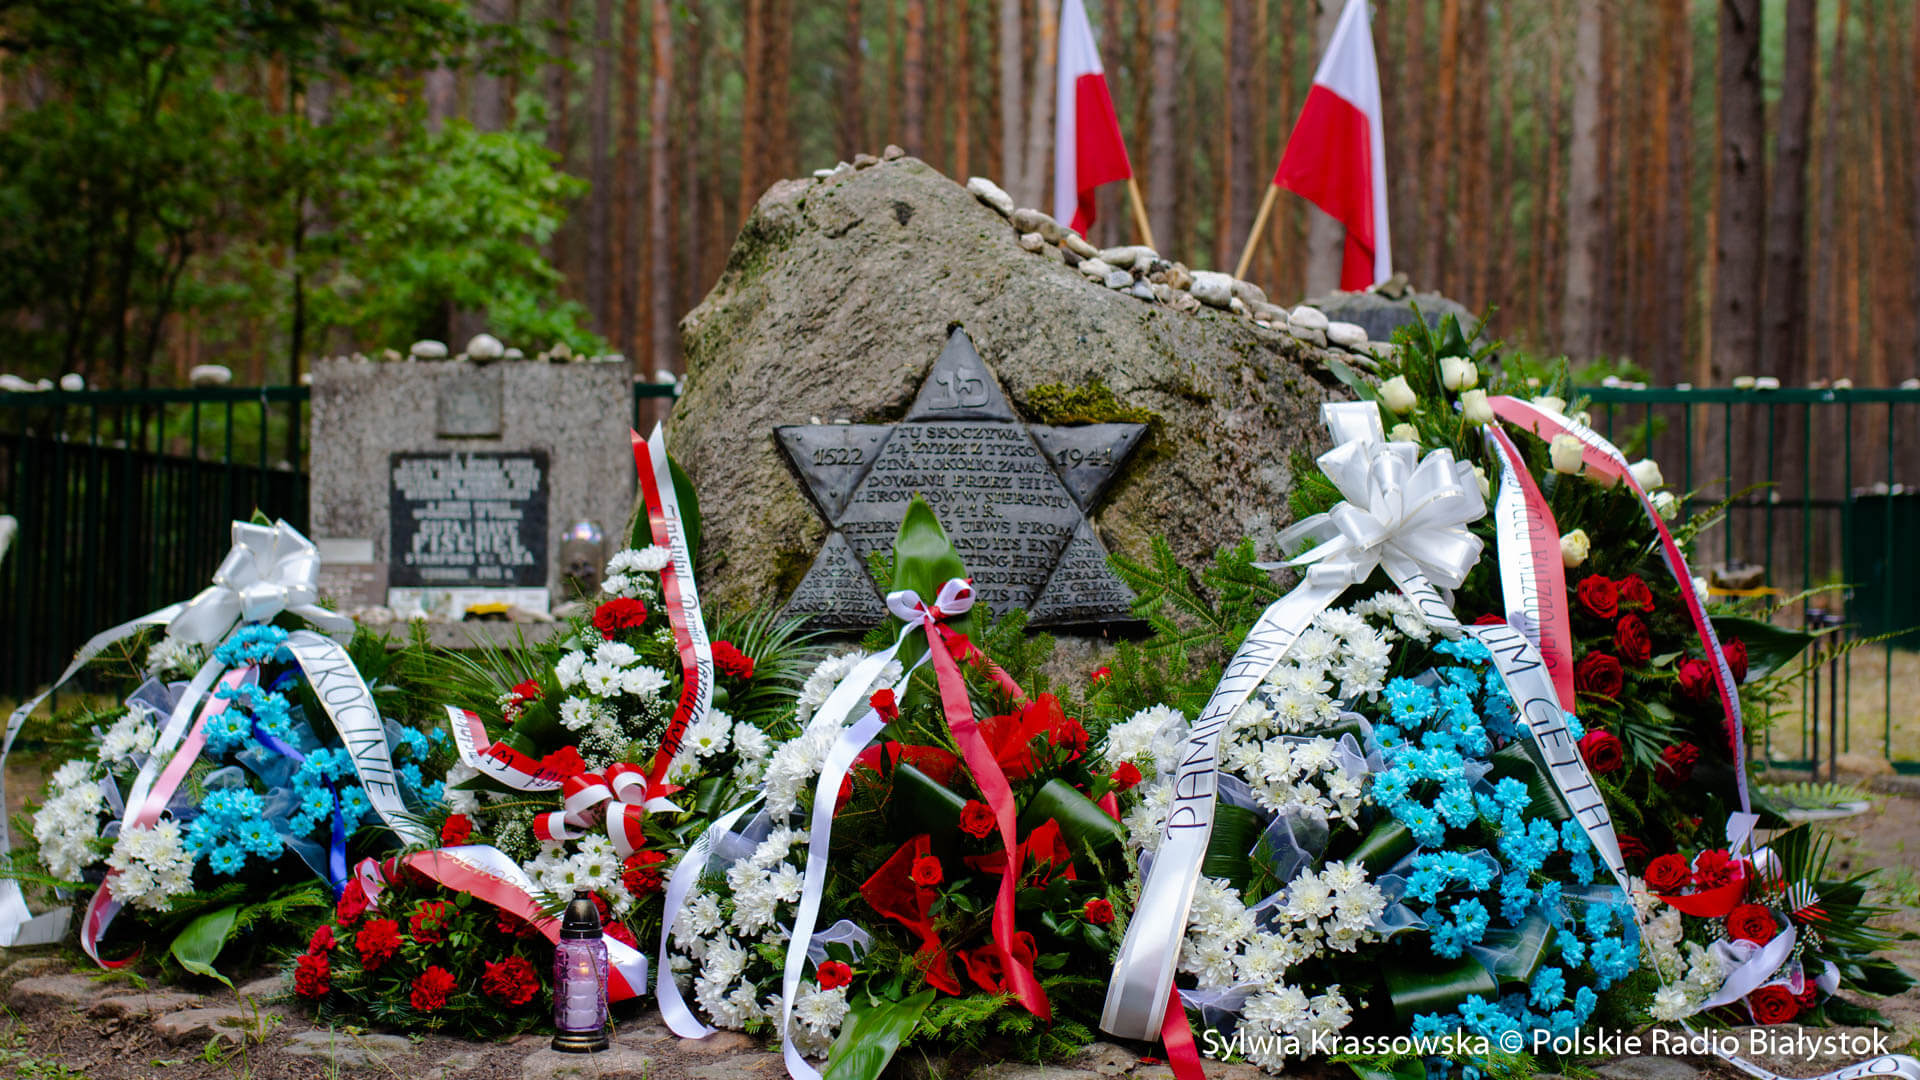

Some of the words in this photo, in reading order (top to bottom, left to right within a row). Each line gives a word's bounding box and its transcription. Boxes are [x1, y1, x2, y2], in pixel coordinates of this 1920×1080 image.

[898, 426, 923, 440] TU
[812, 447, 865, 467] 1522
[1056, 447, 1113, 469] 1941
[867, 474, 946, 488] DOWANI
[951, 474, 1013, 489] PRZEZ
[962, 490, 982, 503] W
[961, 521, 1012, 534] JEWS
[1017, 520, 1074, 537] FROM
[968, 570, 1049, 586] URDERED
